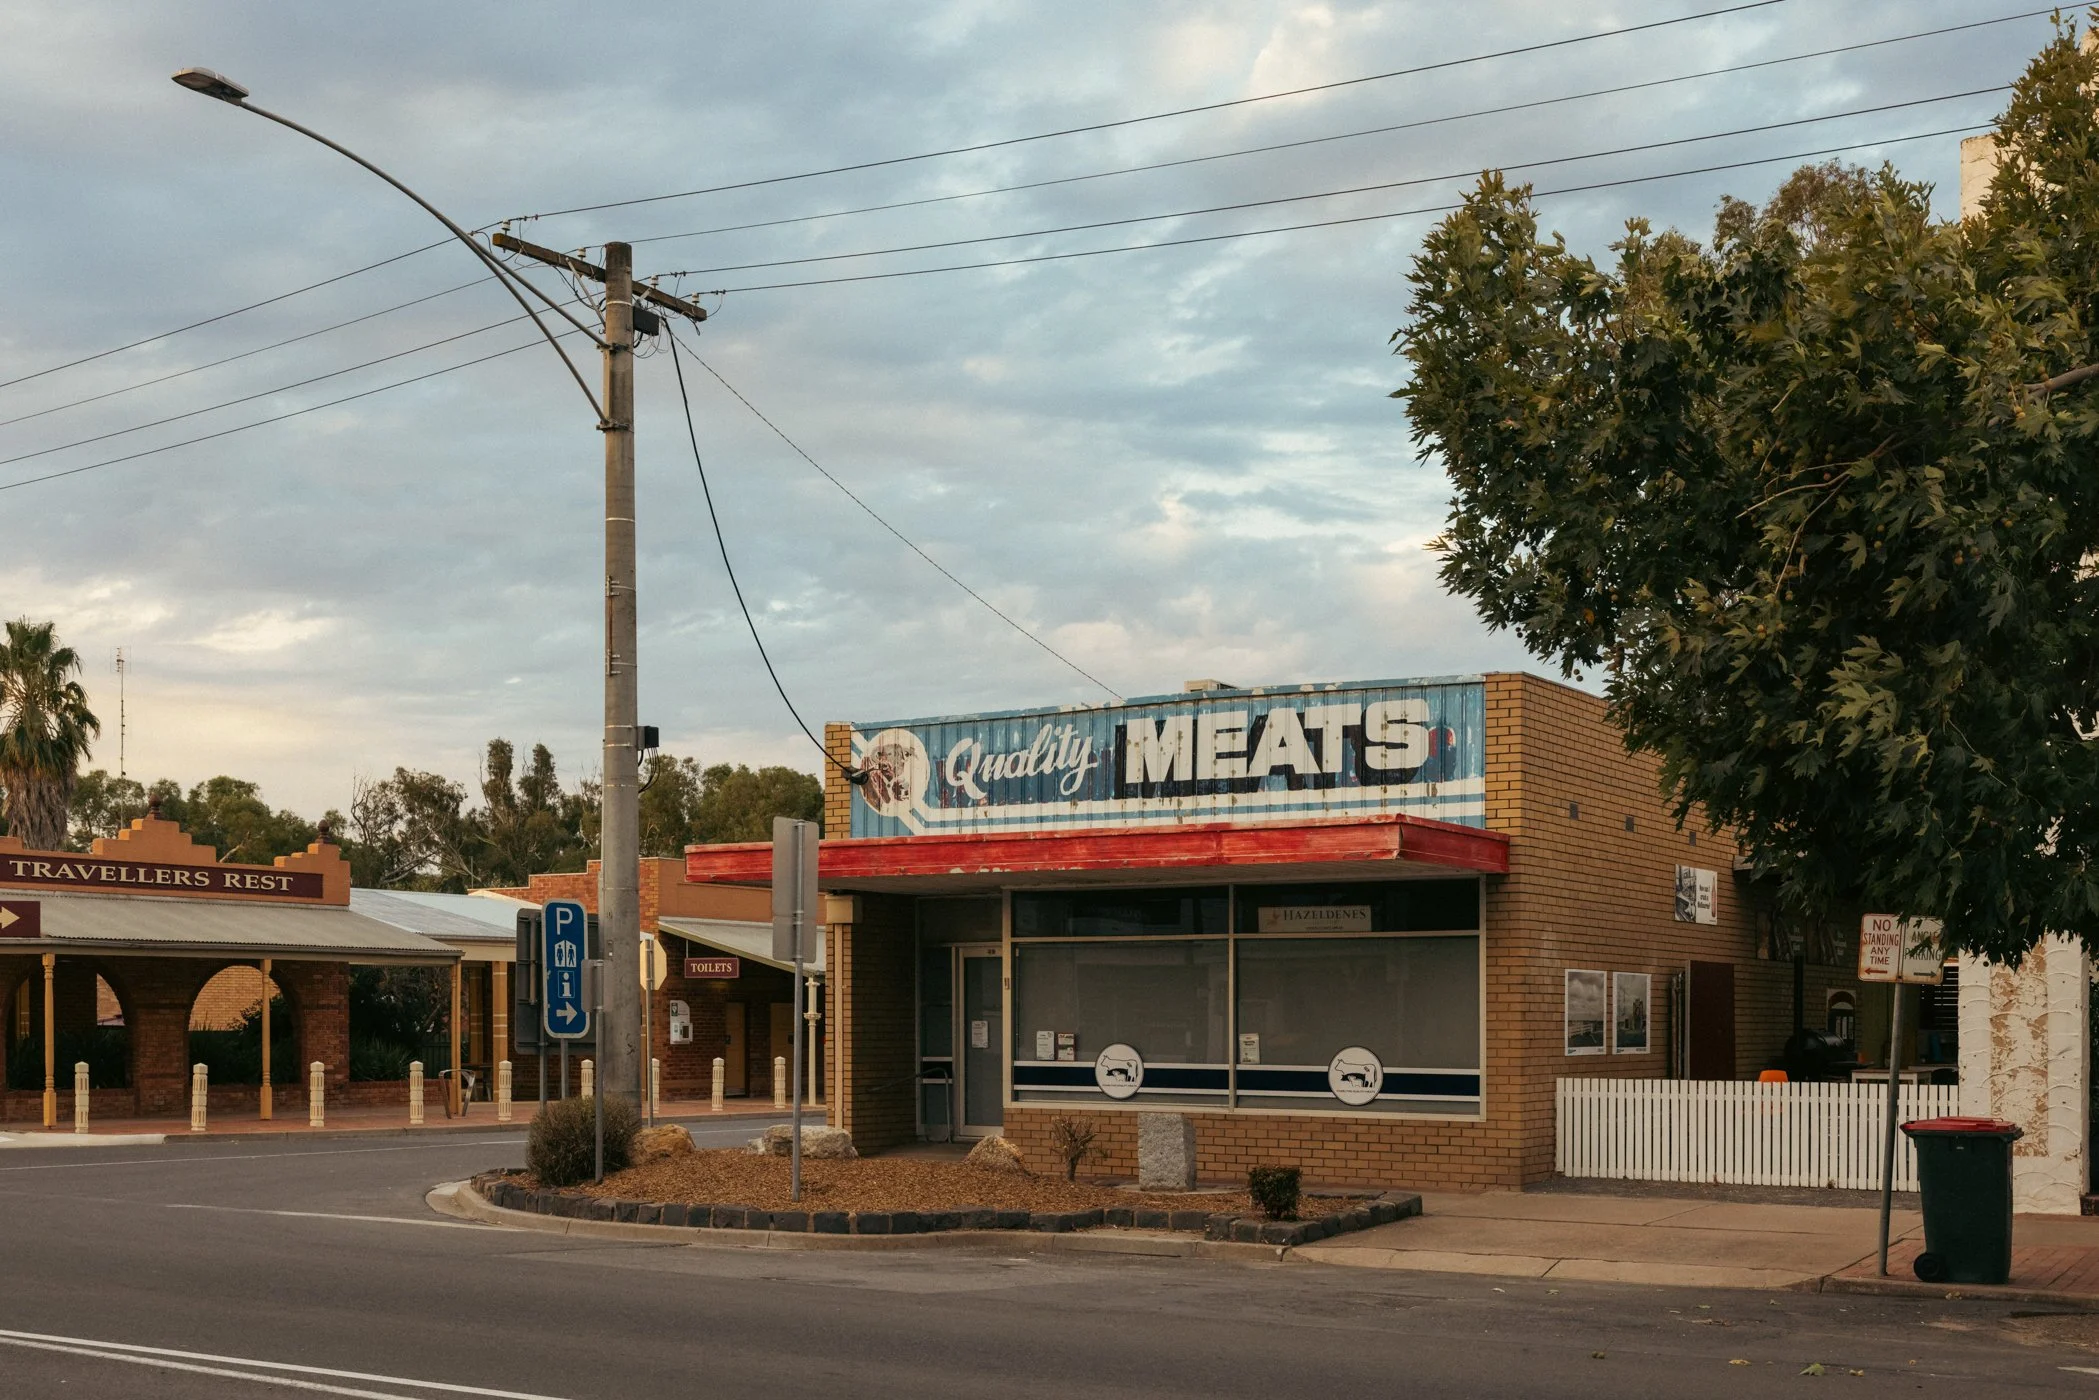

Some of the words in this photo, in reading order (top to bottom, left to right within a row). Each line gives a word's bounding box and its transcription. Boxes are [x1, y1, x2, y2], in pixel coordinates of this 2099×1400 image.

[945, 723, 1098, 800] Quality
[1124, 699, 1432, 786] MEATS
[9, 860, 210, 887] TRAVELLERS
[223, 872, 294, 891] REST
[556, 907, 573, 935] P
[1283, 908, 1367, 921] HAZELDENES
[1872, 919, 1891, 932] NO
[1863, 932, 1899, 946] STANDING
[1870, 946, 1890, 955] ANY
[1903, 947, 1942, 961] PRKING
[1870, 955, 1890, 965] TIME
[690, 962, 732, 973] TOILETS
